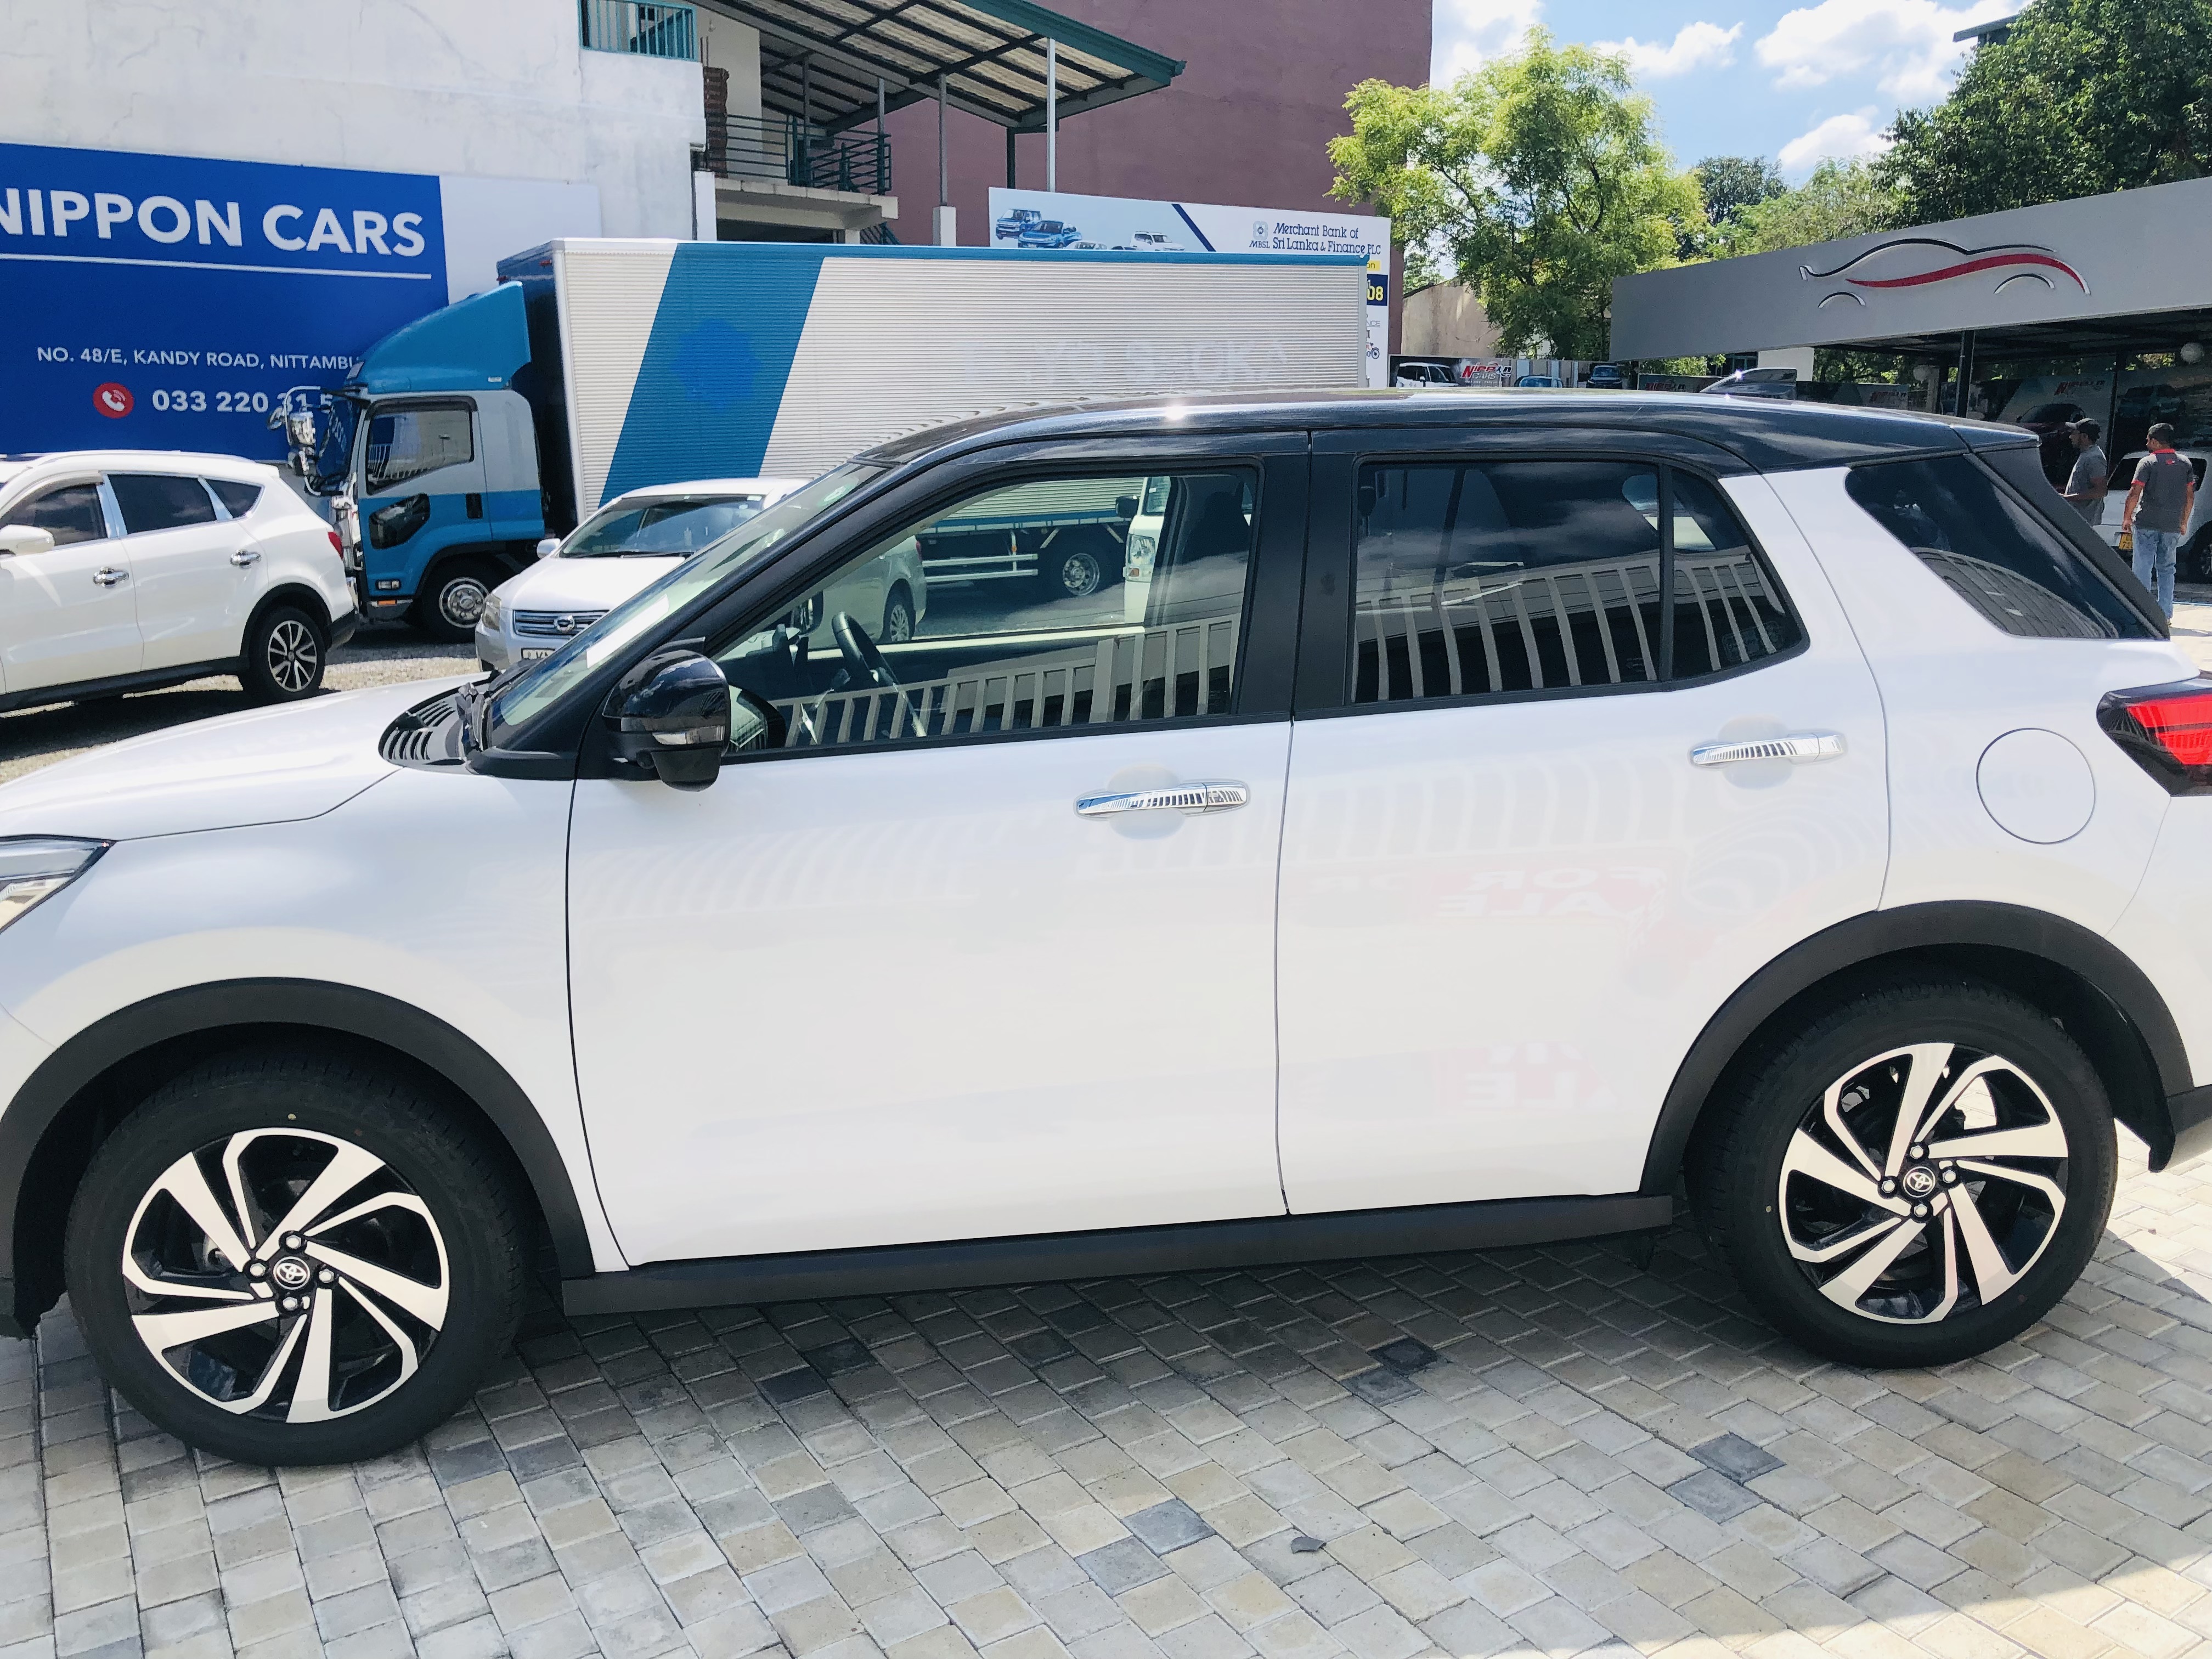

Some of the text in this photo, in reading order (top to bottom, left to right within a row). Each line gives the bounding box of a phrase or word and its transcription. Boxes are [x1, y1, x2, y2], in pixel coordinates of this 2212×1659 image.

[0, 188, 425, 257] NIPPON CARS
[1273, 222, 1358, 239] Merchant Bank of
[1249, 240, 1270, 249] MBSL
[1273, 237, 1381, 255] Sri Lanka & Finance PLC
[37, 347, 74, 362] NO.
[81, 348, 127, 365] 48/E,
[134, 349, 200, 366] KANDY
[206, 352, 264, 370] ROAD,
[153, 390, 206, 411] 033
[216, 392, 268, 413] 220
